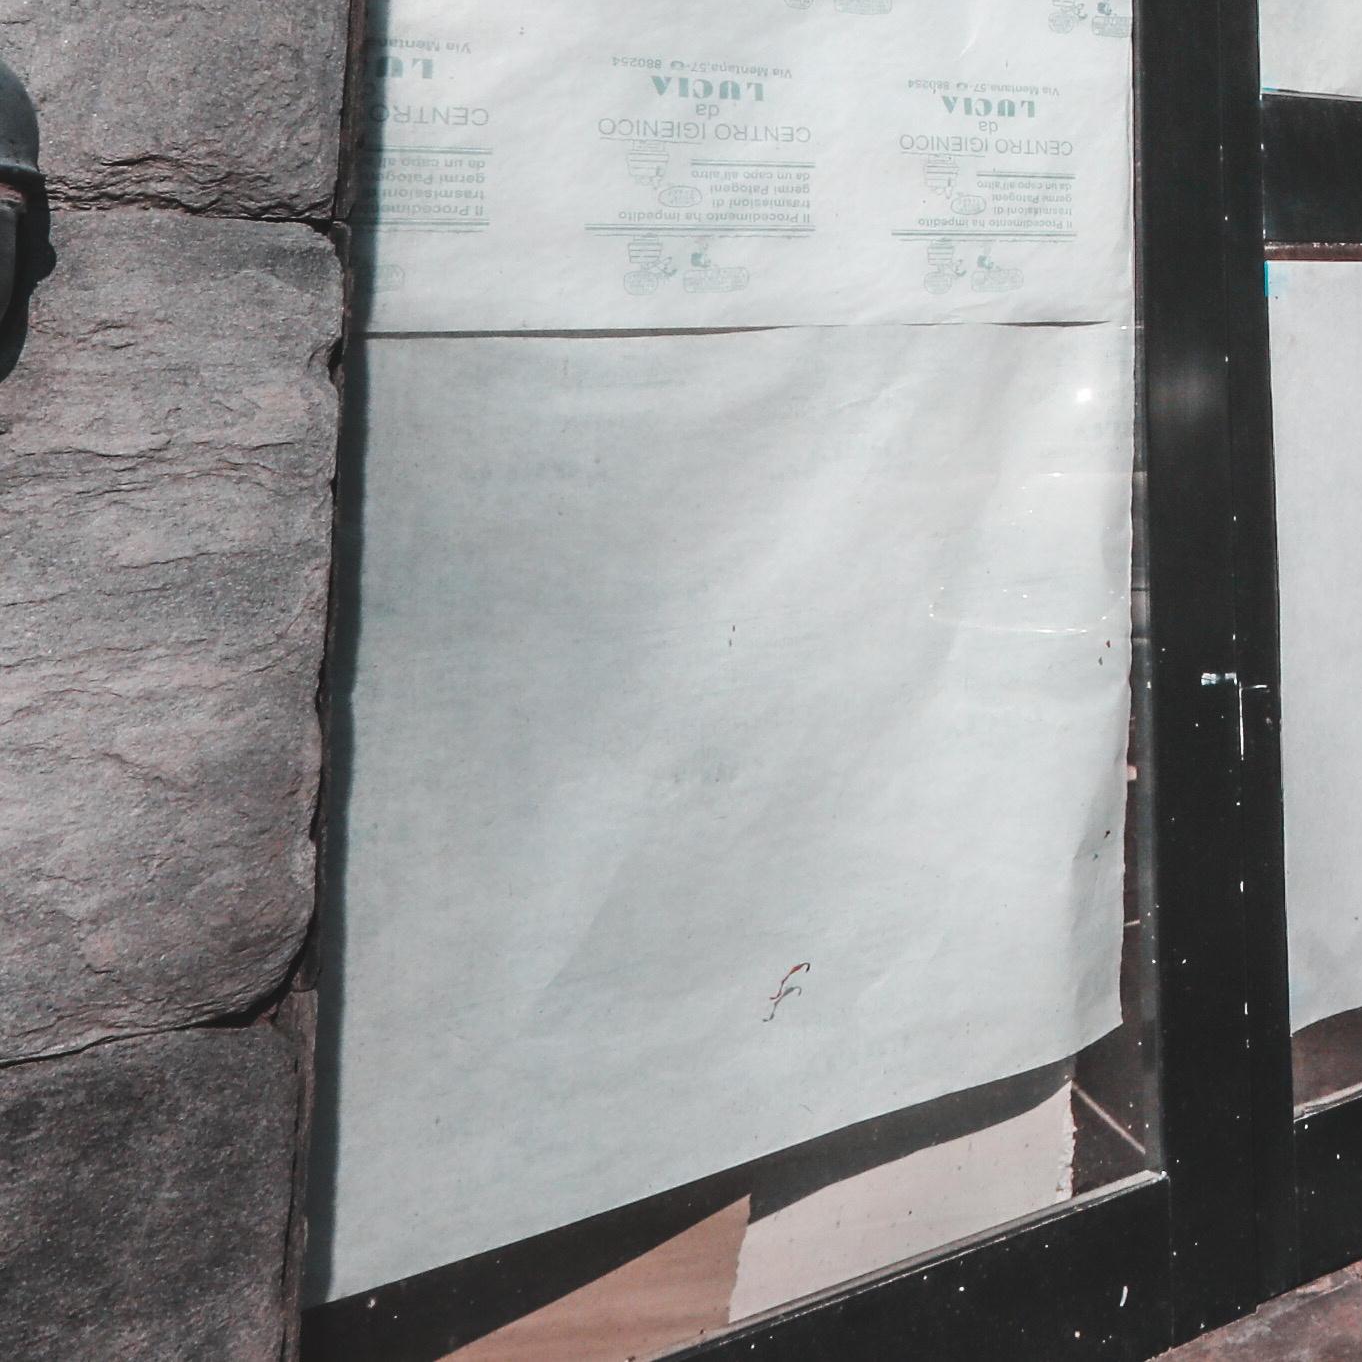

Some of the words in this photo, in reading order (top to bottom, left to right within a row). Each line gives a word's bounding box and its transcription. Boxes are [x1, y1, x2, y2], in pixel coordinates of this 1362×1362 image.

[772, 68, 792, 80] Via
[650, 75, 765, 102] LUCIA
[1042, 86, 1059, 97] Via
[695, 103, 720, 120] da
[941, 96, 1035, 118] LUCIA
[597, 118, 705, 140] IGIENICO
[714, 123, 811, 143] CENTRO
[978, 121, 998, 135] da
[898, 134, 988, 153] IGIENICO
[995, 138, 1073, 156] CENTRO
[774, 184, 810, 194] germi
[618, 209, 680, 222] impedito
[685, 212, 701, 222] ha
[706, 212, 799, 223] Procedimento
[972, 219, 985, 228] ha
